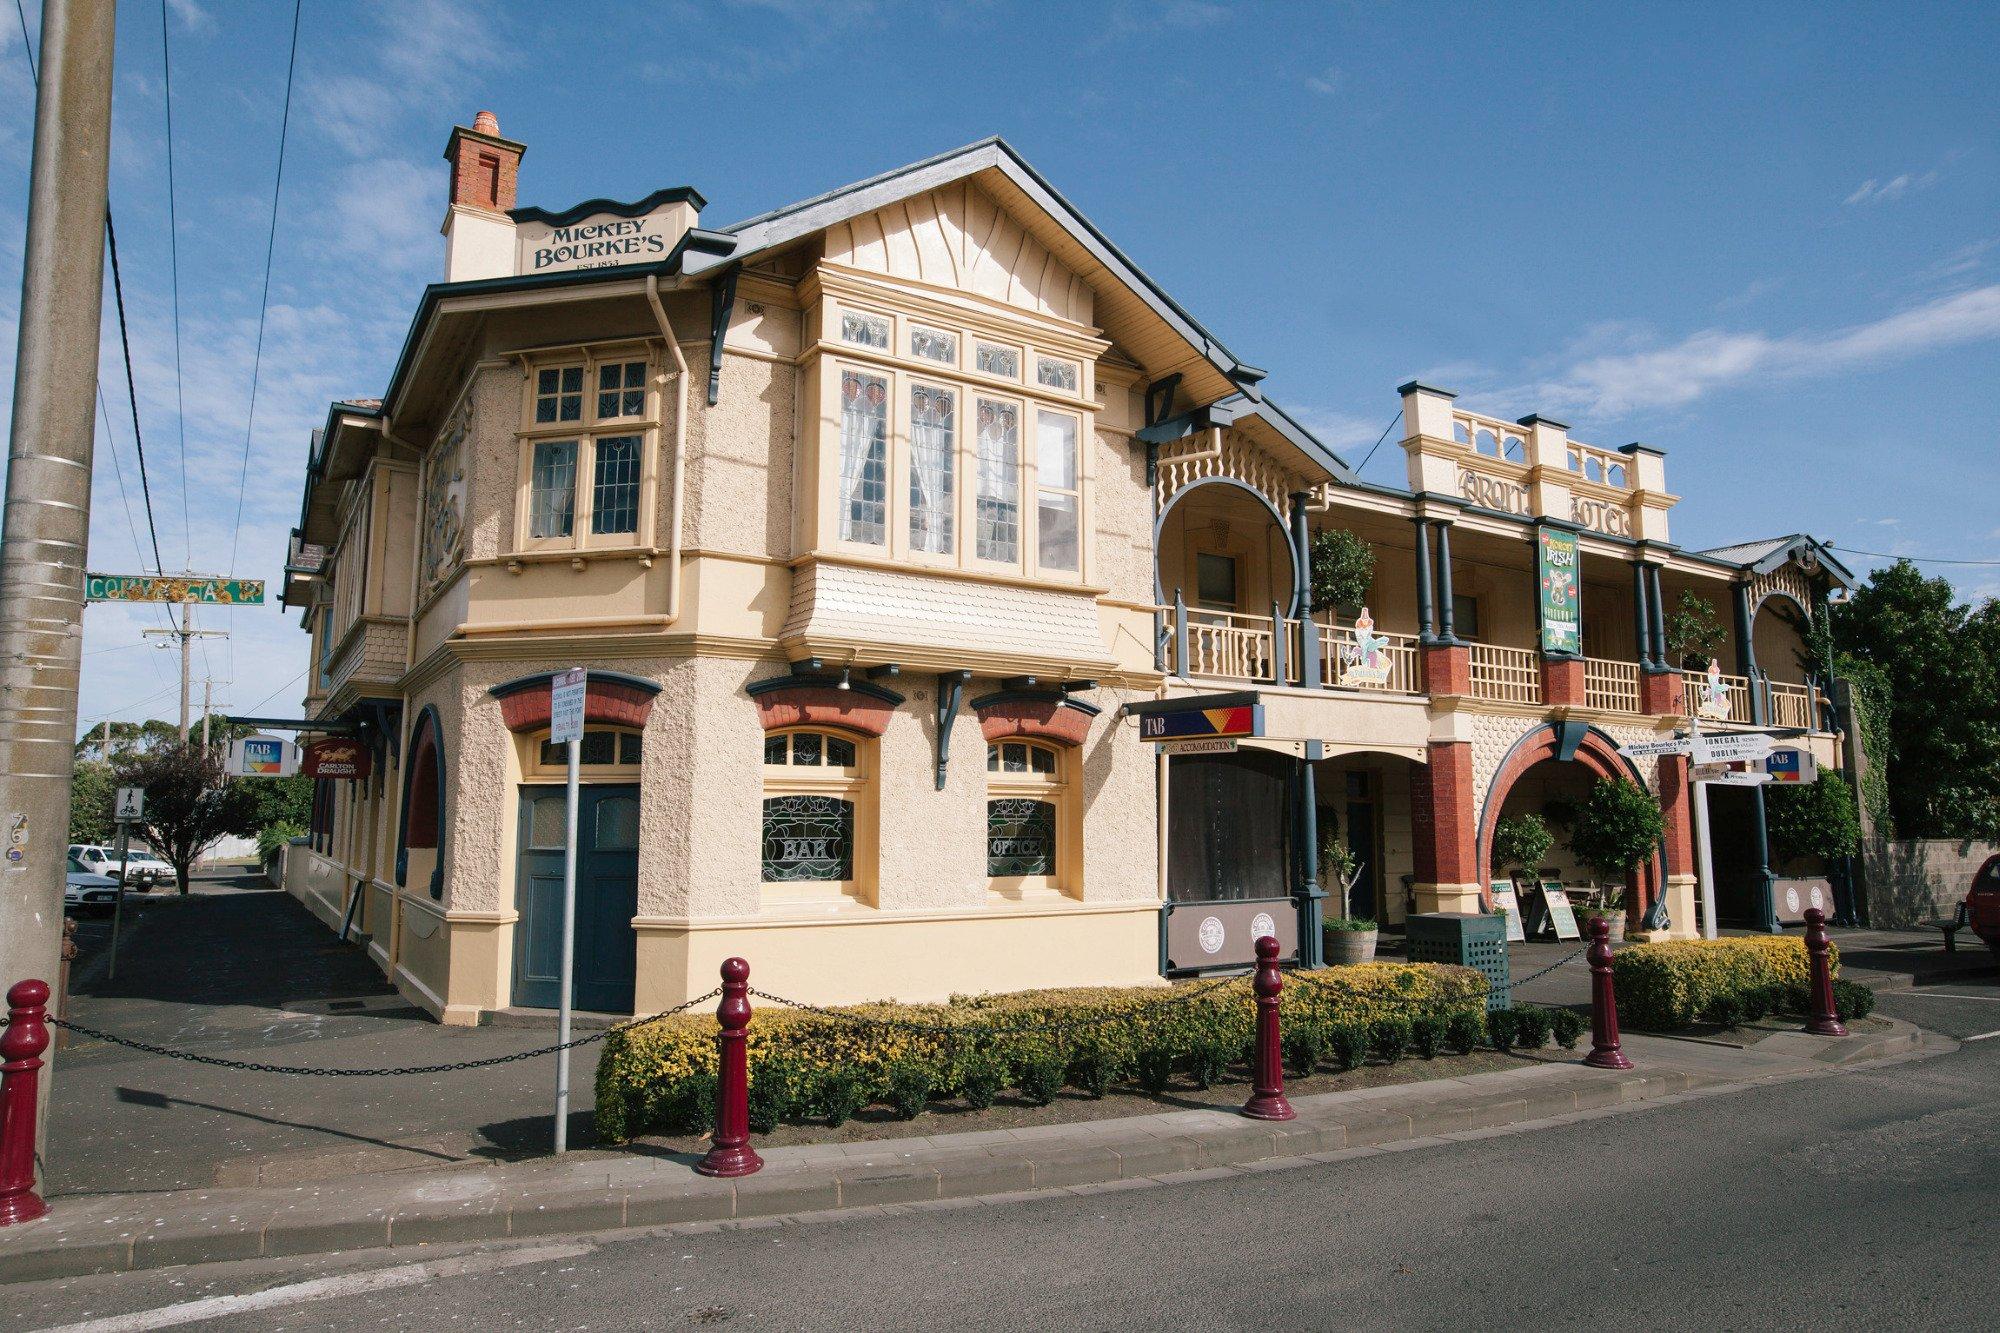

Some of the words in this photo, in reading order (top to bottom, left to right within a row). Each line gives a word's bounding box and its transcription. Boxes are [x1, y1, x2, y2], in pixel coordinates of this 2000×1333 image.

[552, 219, 647, 244] MICKEY
[535, 234, 664, 269] BOURKE'S
[1145, 717, 1166, 735] TAB
[248, 743, 271, 755] TAB
[1179, 740, 1230, 752] ACCOMMODATION
[1710, 749, 1739, 758] DUBLIN
[1770, 754, 1789, 764] TAB
[782, 840, 830, 860] BAR
[992, 839, 1042, 855] OFFICE
